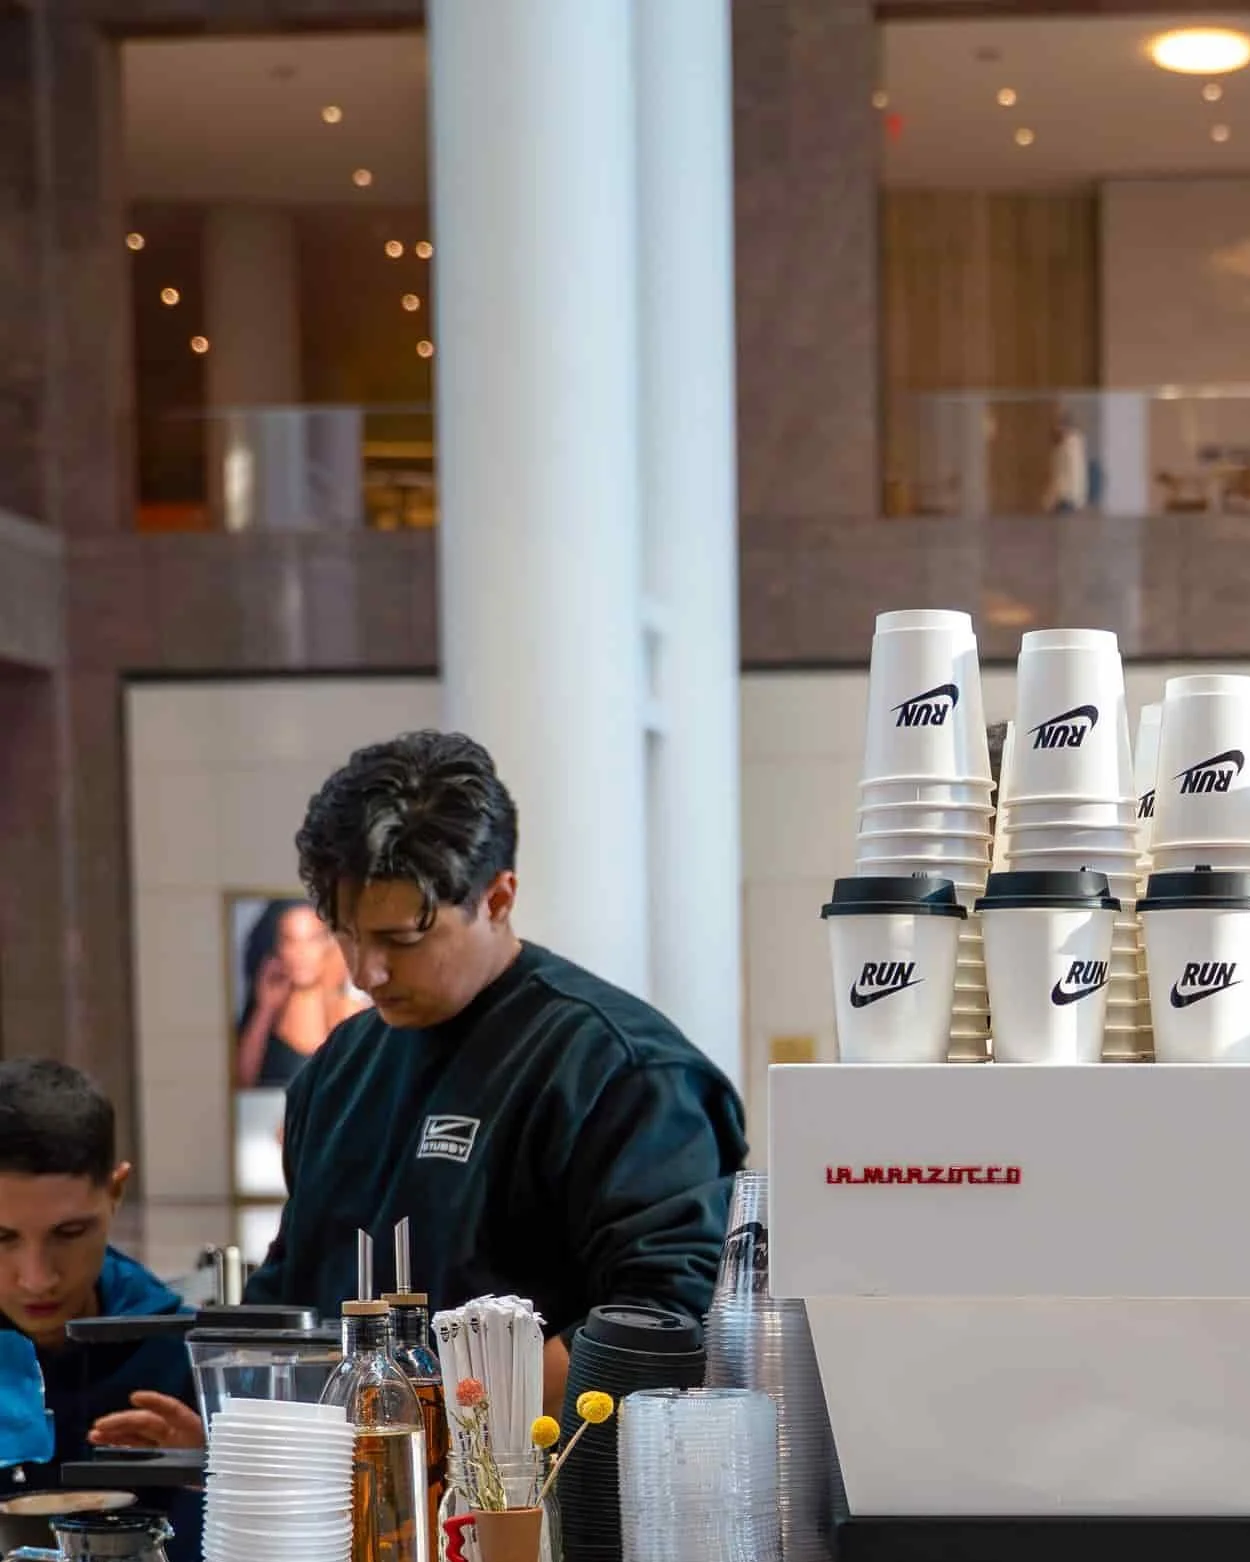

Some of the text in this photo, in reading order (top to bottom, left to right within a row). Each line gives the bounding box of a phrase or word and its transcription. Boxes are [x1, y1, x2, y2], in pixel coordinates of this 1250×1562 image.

[896, 703, 949, 728] RUN
[1033, 724, 1087, 749] RUN
[1180, 769, 1234, 794] RUN
[860, 962, 916, 986] RUN
[1065, 961, 1108, 985] RUN
[1181, 962, 1237, 986] RUN
[826, 1166, 1022, 1184] LA MARZOCCO
